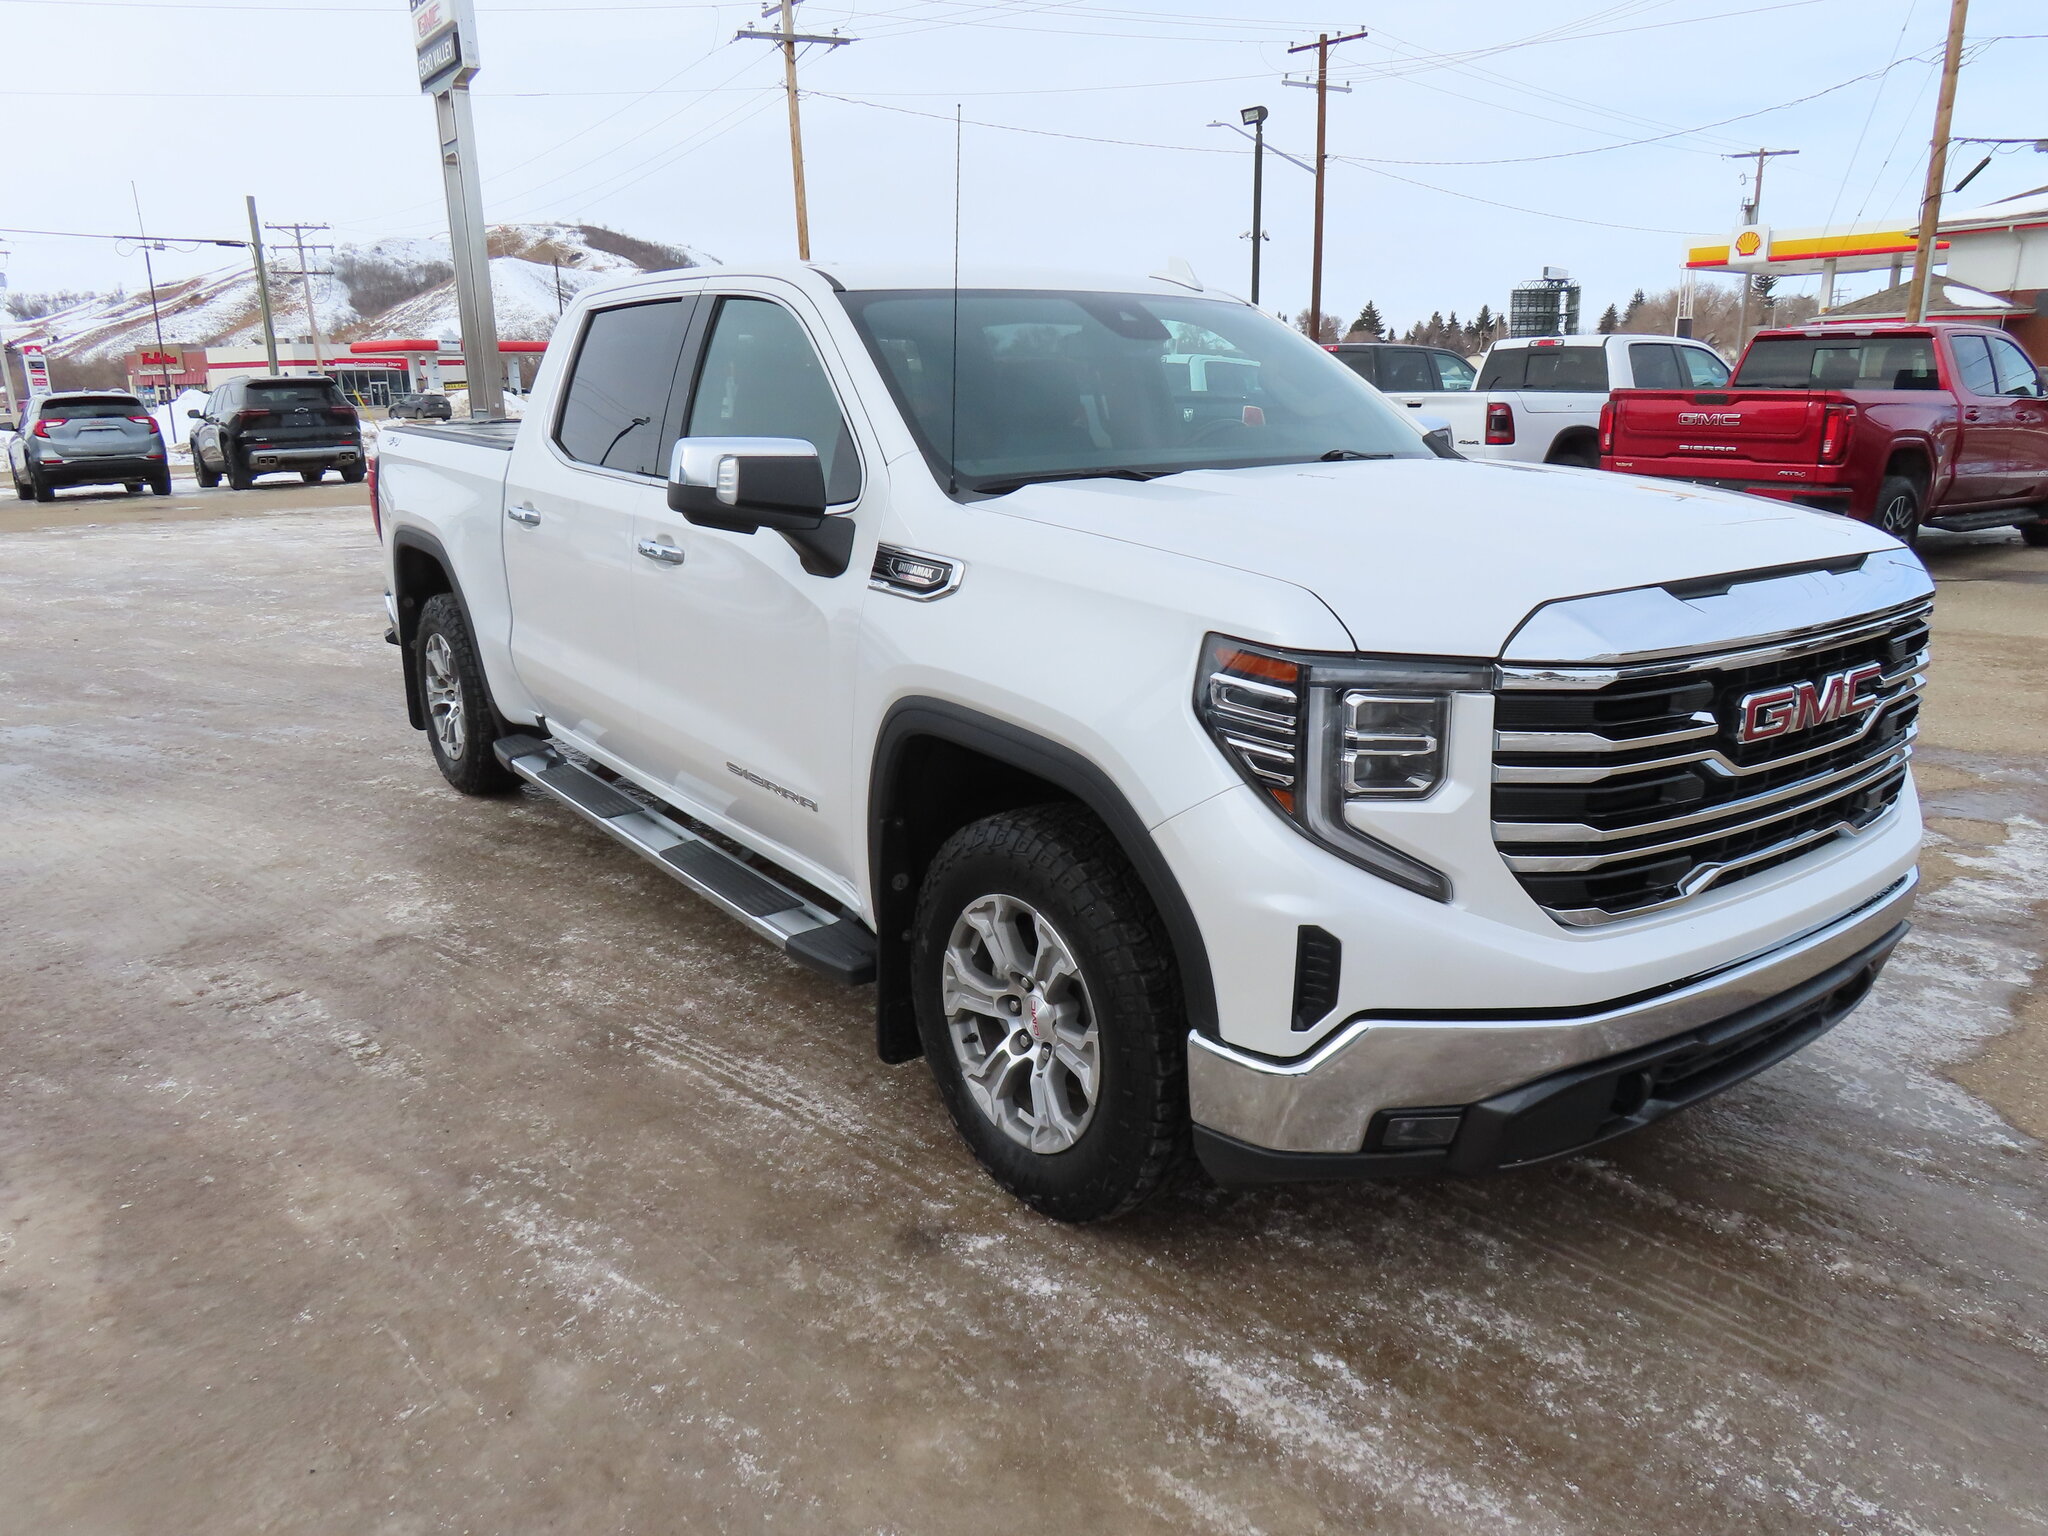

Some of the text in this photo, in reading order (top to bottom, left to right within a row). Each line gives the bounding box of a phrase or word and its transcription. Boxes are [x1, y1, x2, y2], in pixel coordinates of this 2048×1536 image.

[417, 3, 441, 38] GMC
[432, 40, 453, 68] VALLEY
[1677, 412, 1742, 427] GMC
[1678, 444, 1737, 452] SIERRA
[897, 561, 935, 578] DURAMAX
[1737, 660, 1882, 745] GMC
[726, 761, 819, 812] SIERRA
[1030, 1000, 1040, 1036] GMC
